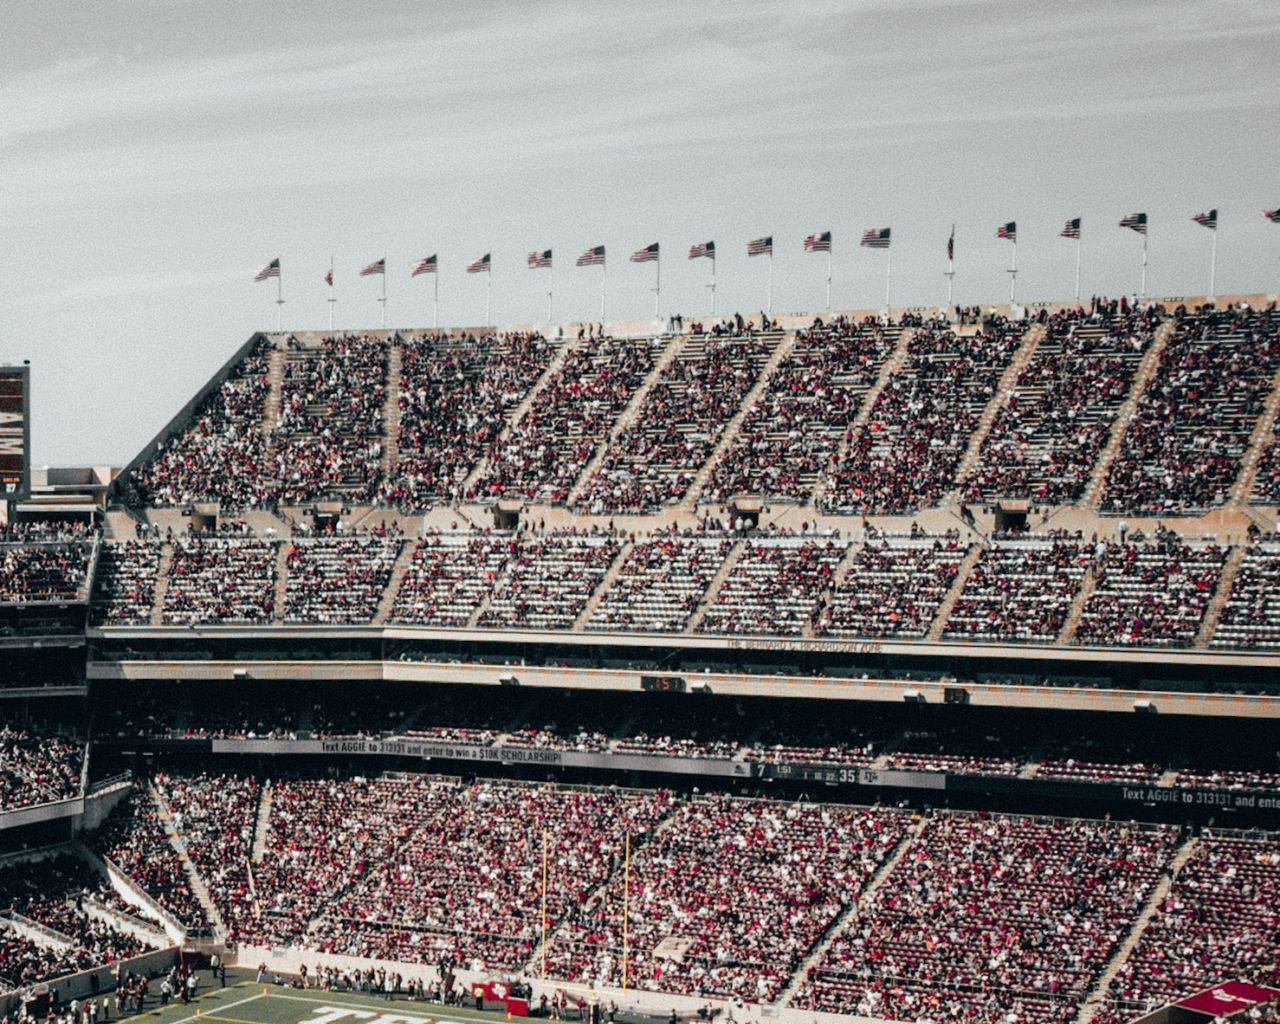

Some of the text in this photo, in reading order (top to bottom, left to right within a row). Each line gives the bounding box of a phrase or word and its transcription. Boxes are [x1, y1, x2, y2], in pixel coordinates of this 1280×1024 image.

[322, 742, 339, 752] Text
[341, 742, 366, 752] AGGIE
[369, 743, 378, 752] to
[407, 745, 422, 754] and
[456, 749, 470, 758] win
[479, 748, 499, 760] $10K
[501, 751, 562, 763] SCHOLARSHIP!
[757, 765, 765, 777] 7
[839, 769, 856, 783] 35
[1123, 787, 1144, 800] Text
[1147, 789, 1179, 802] AGGIE
[1182, 792, 1193, 803] to
[1196, 792, 1231, 804] 313131
[1235, 795, 1255, 807] and
